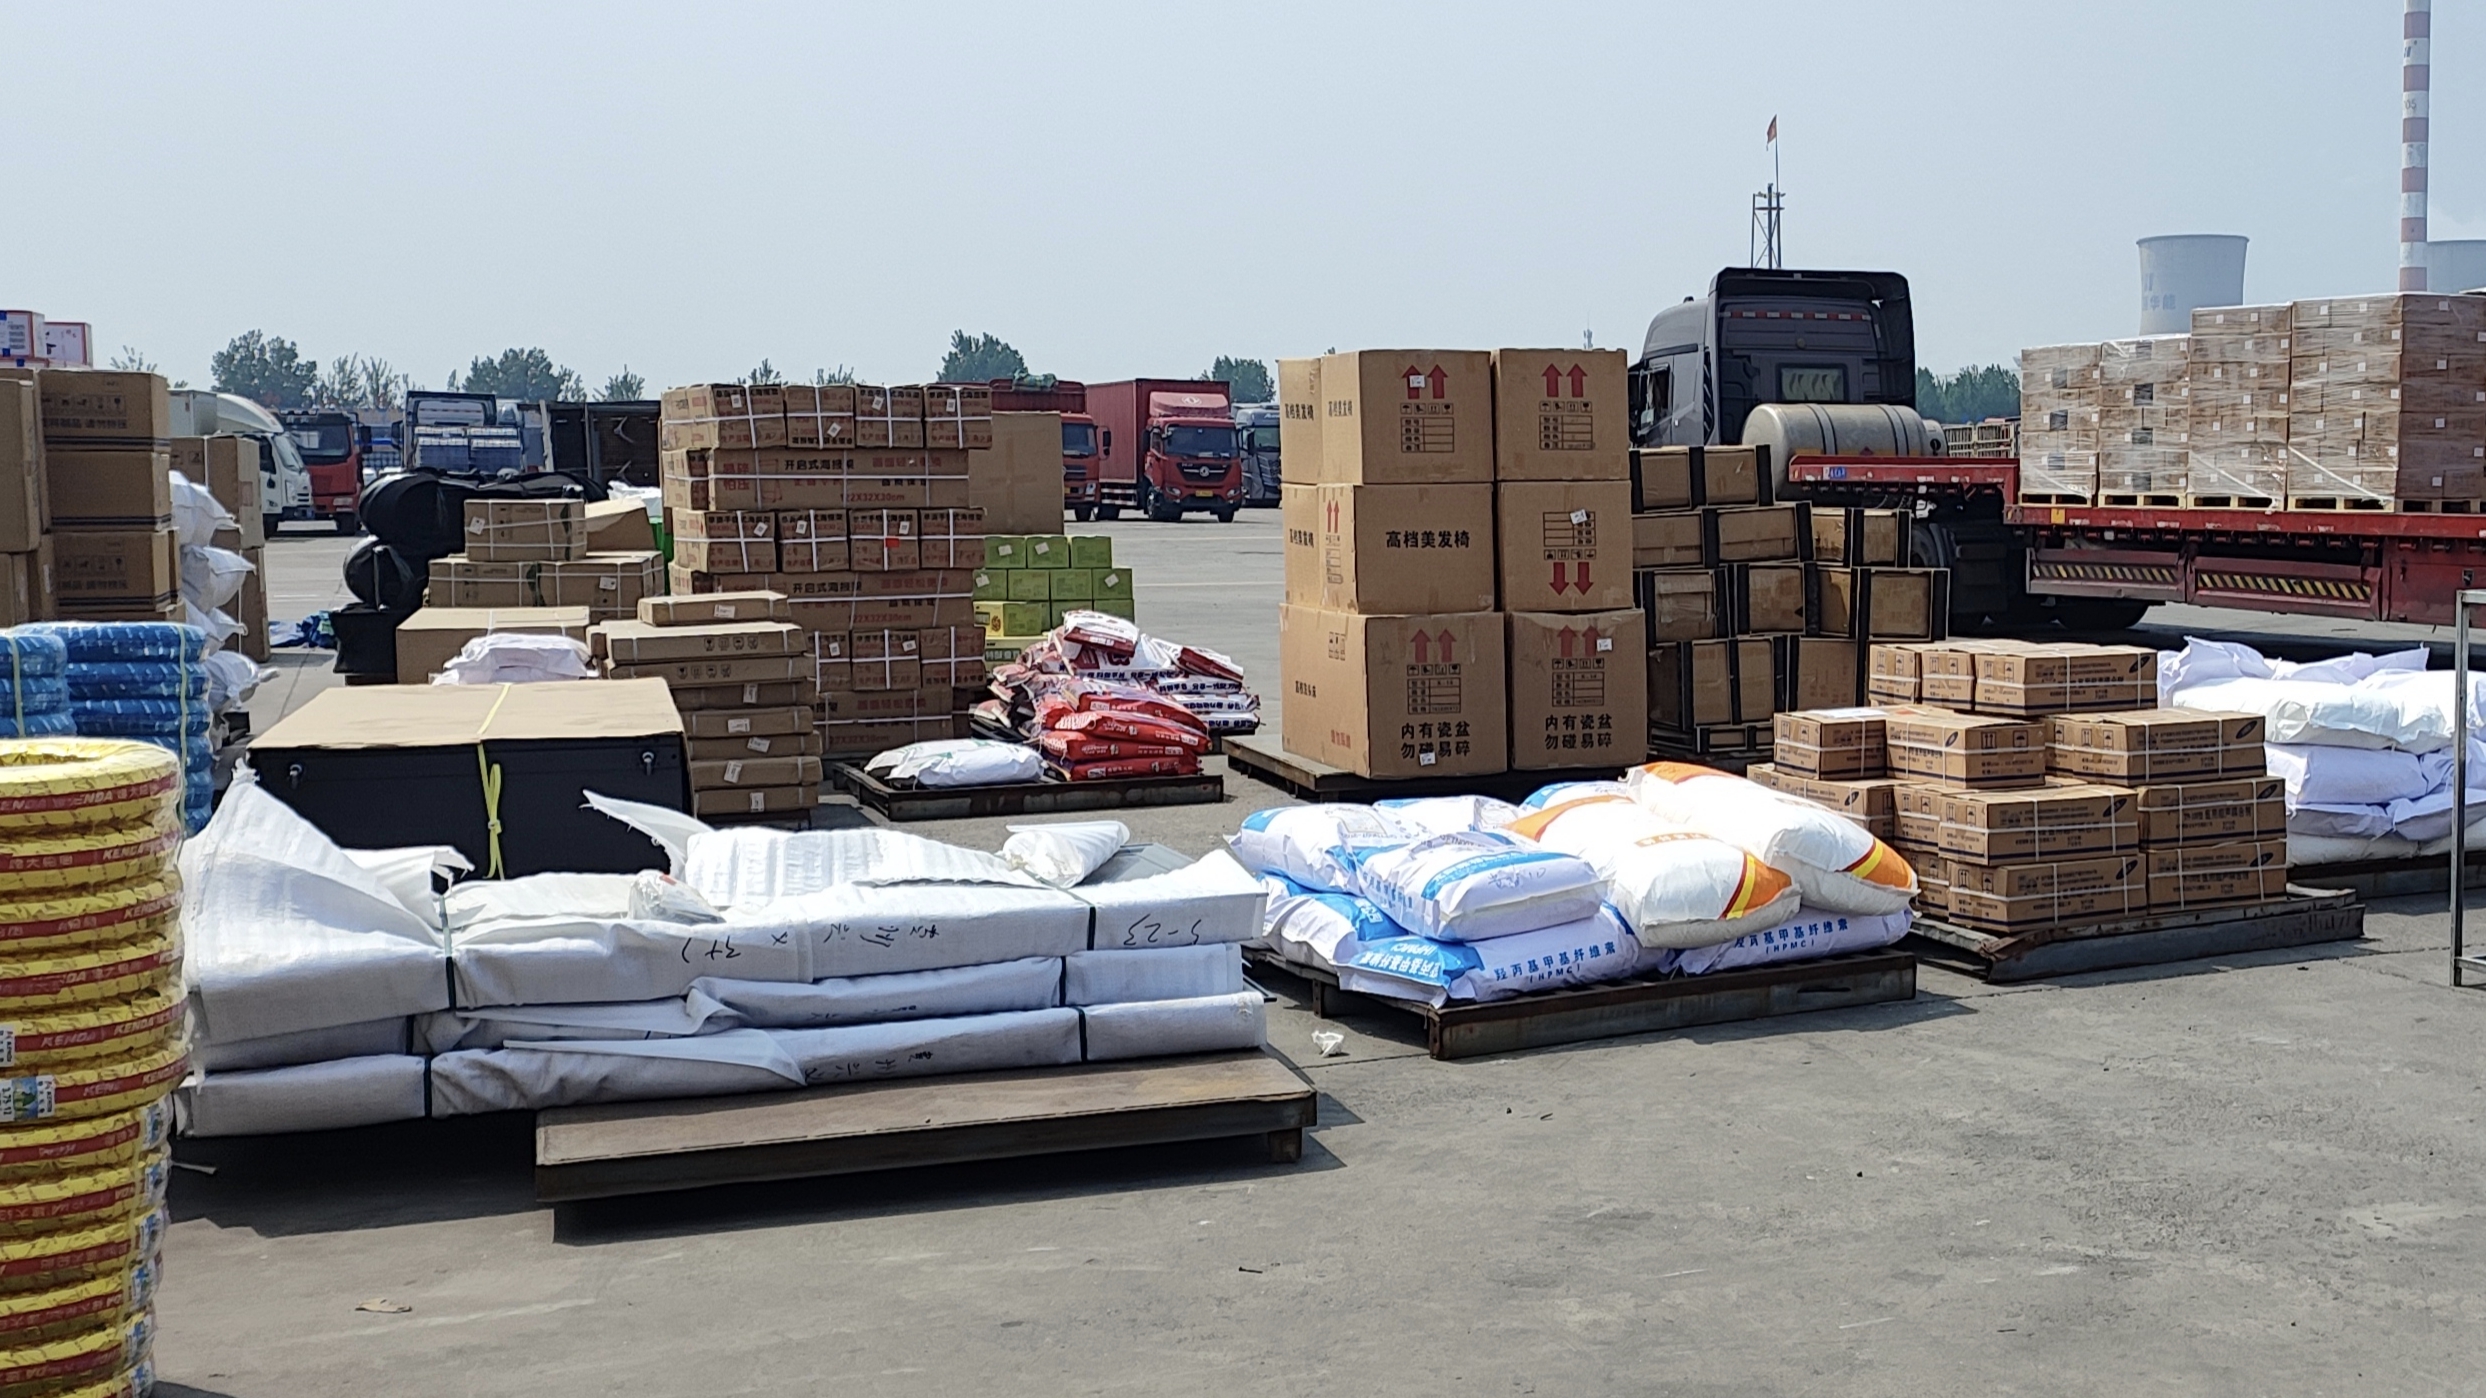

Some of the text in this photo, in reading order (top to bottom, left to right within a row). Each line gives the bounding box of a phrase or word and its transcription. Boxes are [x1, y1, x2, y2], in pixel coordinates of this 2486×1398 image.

[1385, 530, 1471, 549] 高档美发椅
[1401, 720, 1471, 740] 内有瓷盆
[1544, 713, 1613, 732] 内有瓷盆
[1400, 740, 1471, 759] 勿碰易碎
[1544, 732, 1613, 750] 勿碰易碎
[1765, 938, 1815, 955] (HPMC)
[1494, 941, 1616, 982] 羟丙基甲基纤维素
[1529, 963, 1581, 984] (HPMC)
[83, 1082, 121, 1097] KEN
